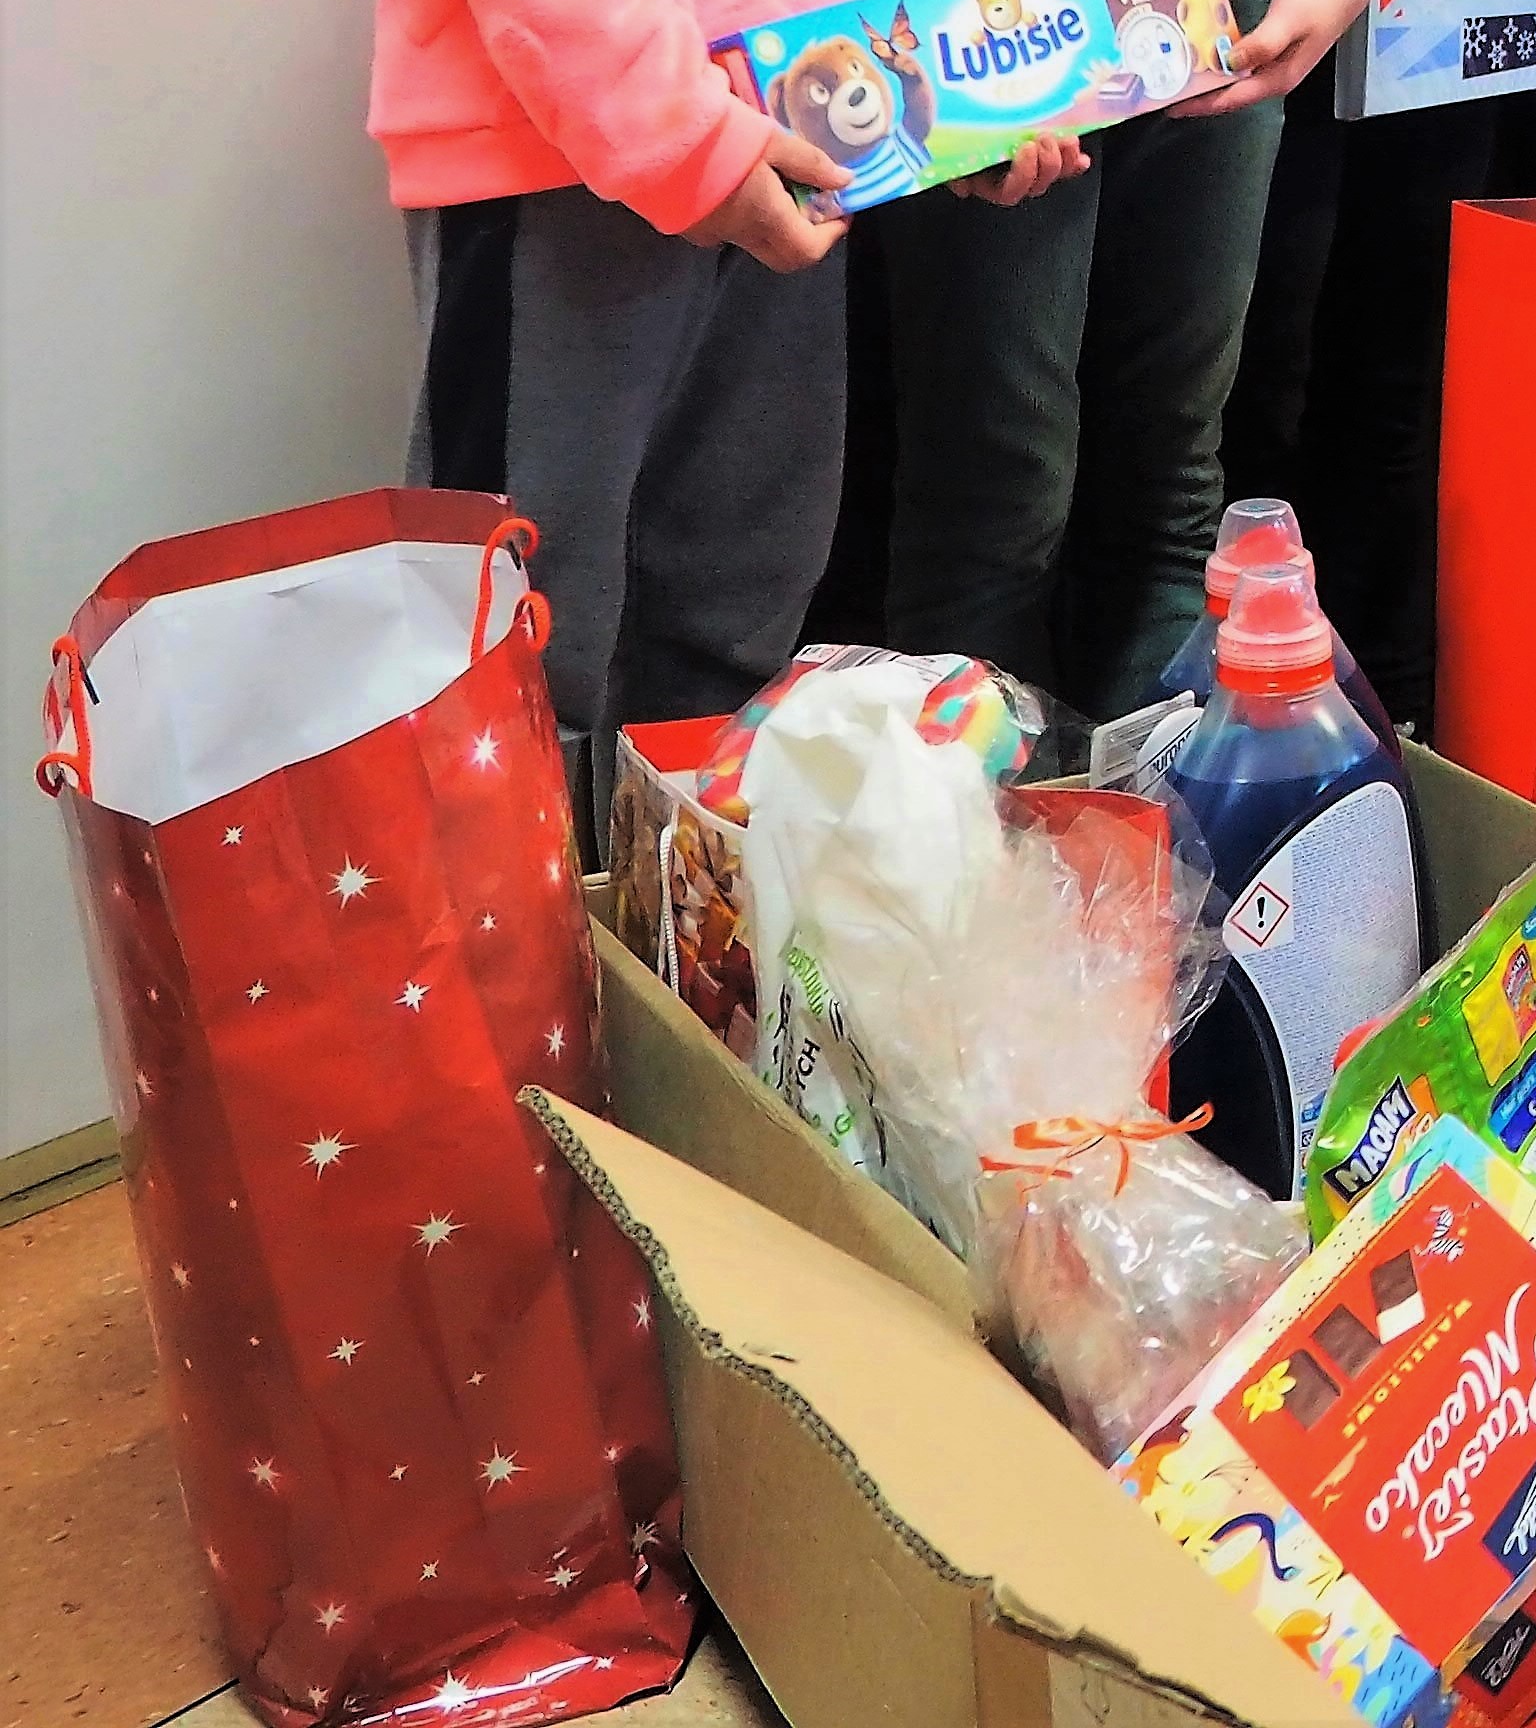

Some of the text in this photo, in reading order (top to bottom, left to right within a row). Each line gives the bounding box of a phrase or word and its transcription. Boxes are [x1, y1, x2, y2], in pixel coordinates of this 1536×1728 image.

[938, 7, 1084, 83] Lubisie
[1335, 1088, 1411, 1193] MAOAM
[1365, 1281, 1532, 1534] Mleczko
